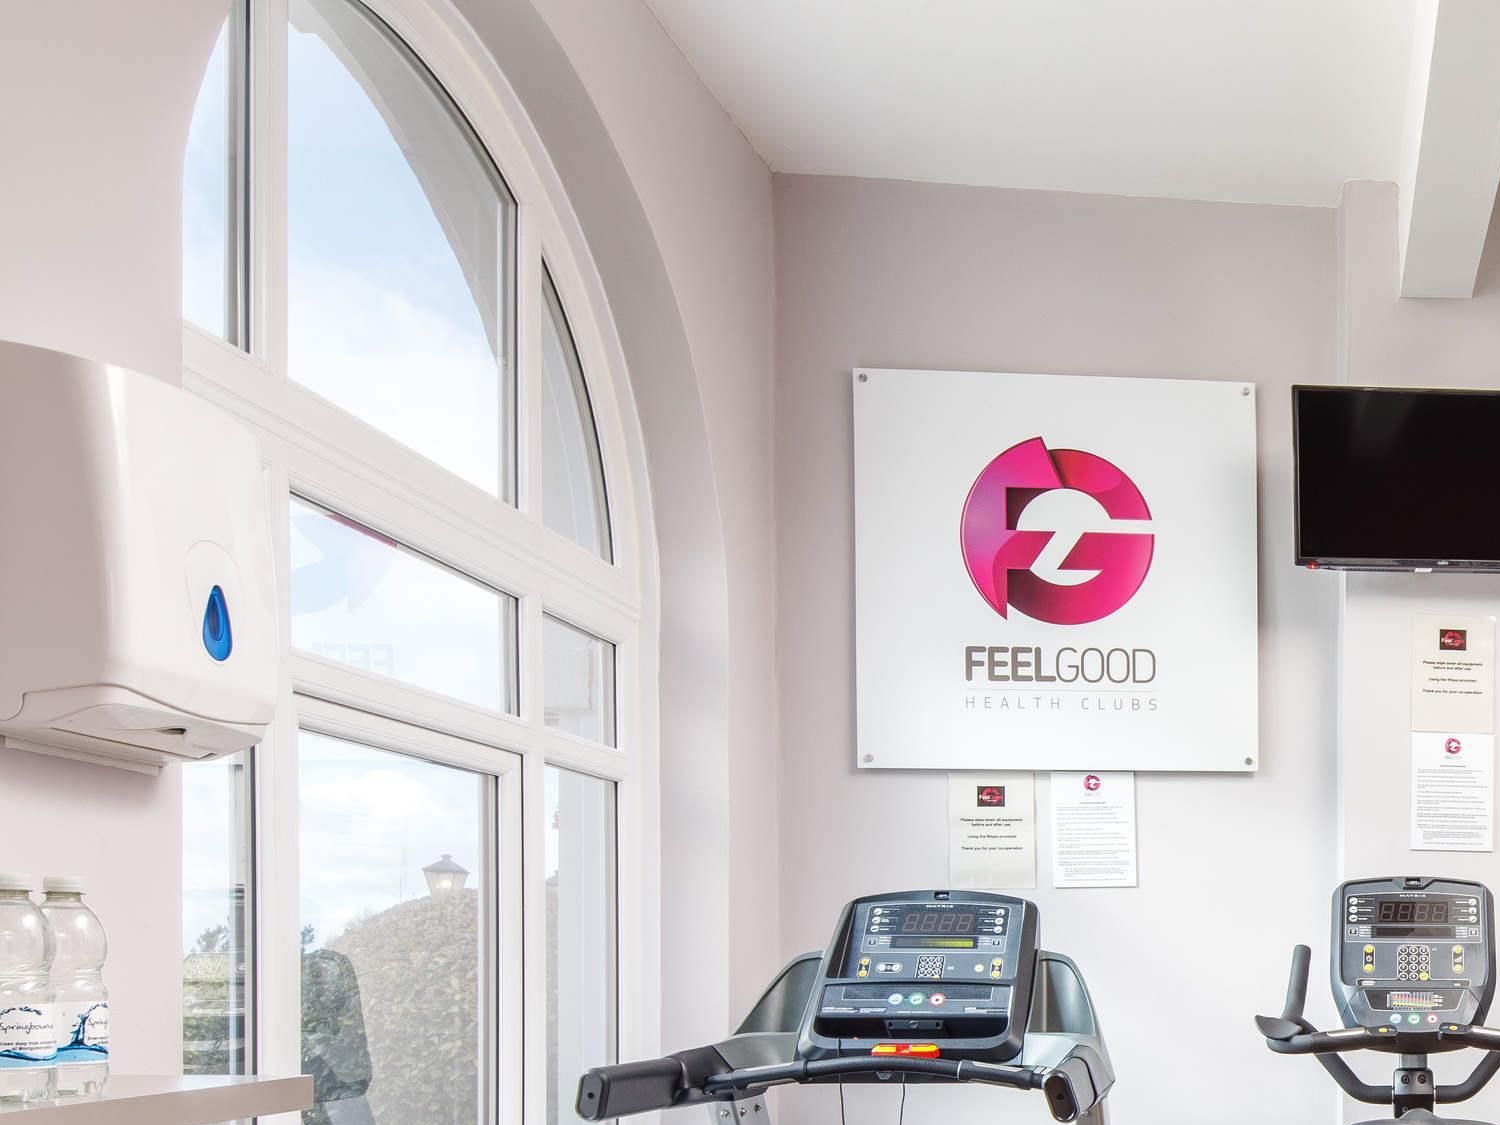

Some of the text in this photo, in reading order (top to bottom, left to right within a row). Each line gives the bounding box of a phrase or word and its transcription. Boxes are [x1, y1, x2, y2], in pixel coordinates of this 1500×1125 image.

[965, 646, 1156, 683] FEELGOOD
[965, 696, 1158, 711] HEALTH CLUBS
